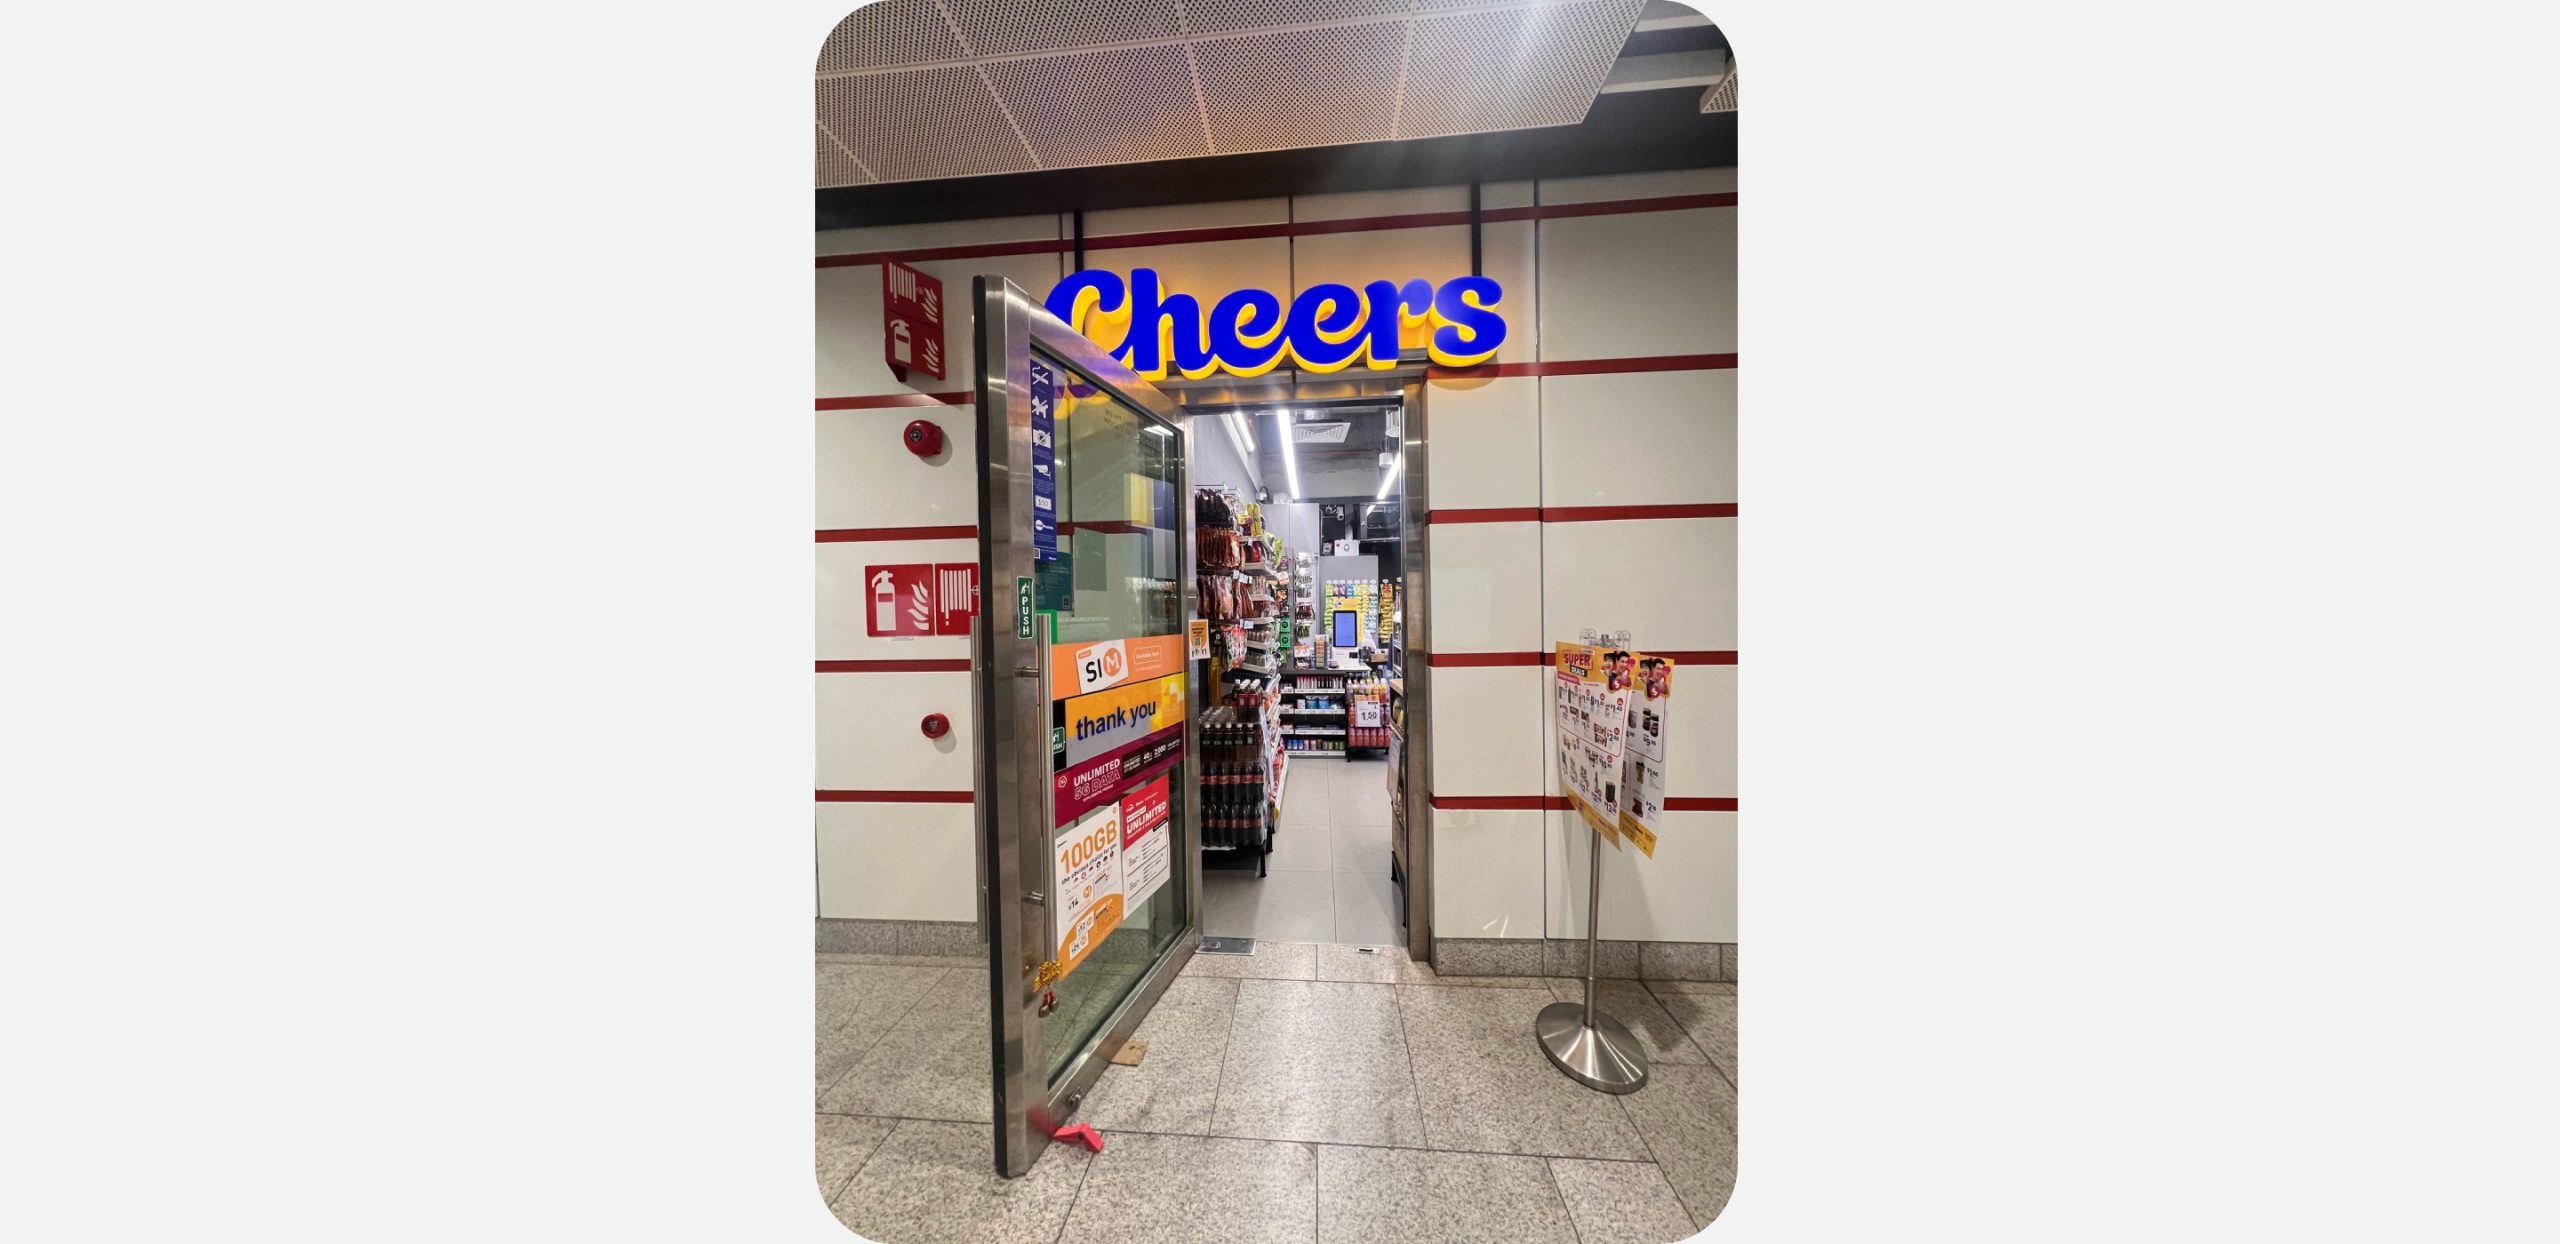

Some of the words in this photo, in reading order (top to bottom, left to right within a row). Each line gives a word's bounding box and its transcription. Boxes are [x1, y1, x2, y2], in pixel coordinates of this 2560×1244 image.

[1045, 267, 1507, 381] Cheers
[1563, 653, 1591, 667] SUPER
[1076, 711, 1126, 741] thank
[1130, 701, 1156, 727] you
[1073, 758, 1121, 787] UNLIMITED
[1074, 784, 1091, 801] 5G
[1091, 769, 1121, 792] DATA
[1126, 801, 1167, 835] UNLIMITED
[1061, 819, 1117, 874] 100GB
